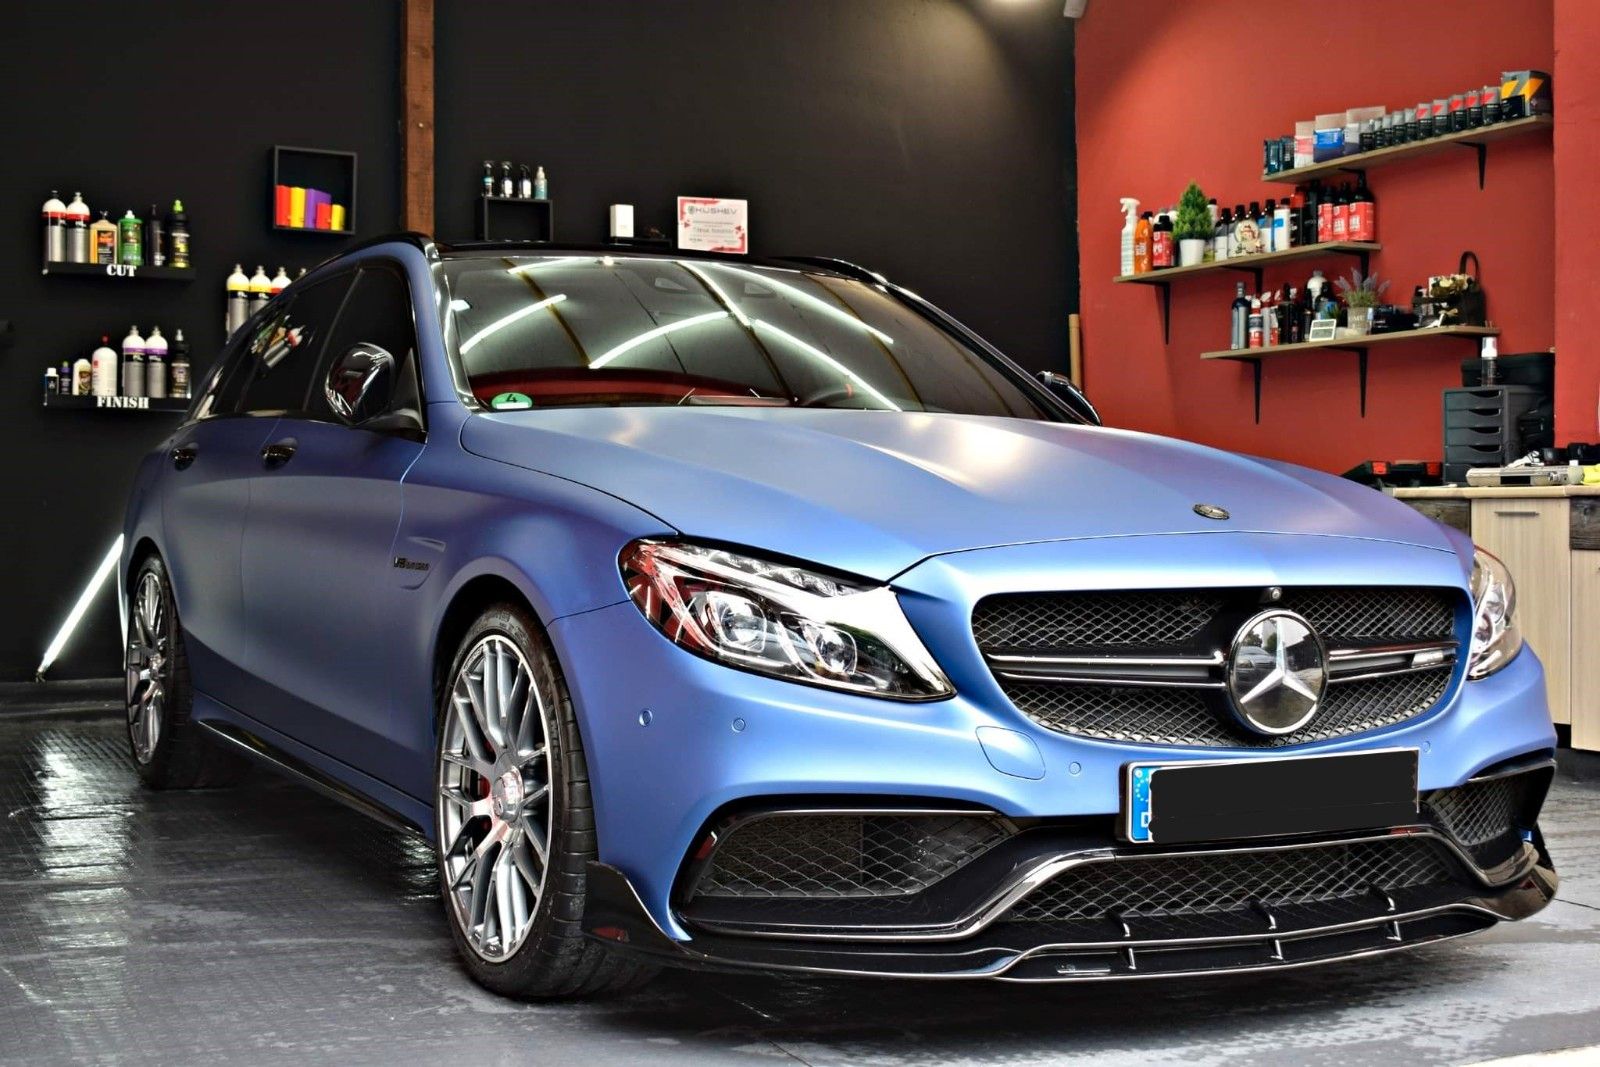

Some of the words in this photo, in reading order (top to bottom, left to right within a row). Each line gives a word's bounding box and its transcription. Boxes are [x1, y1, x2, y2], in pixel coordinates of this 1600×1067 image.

[106, 264, 137, 277] CUT
[97, 396, 149, 409] FINISH
[505, 393, 518, 403] 4
